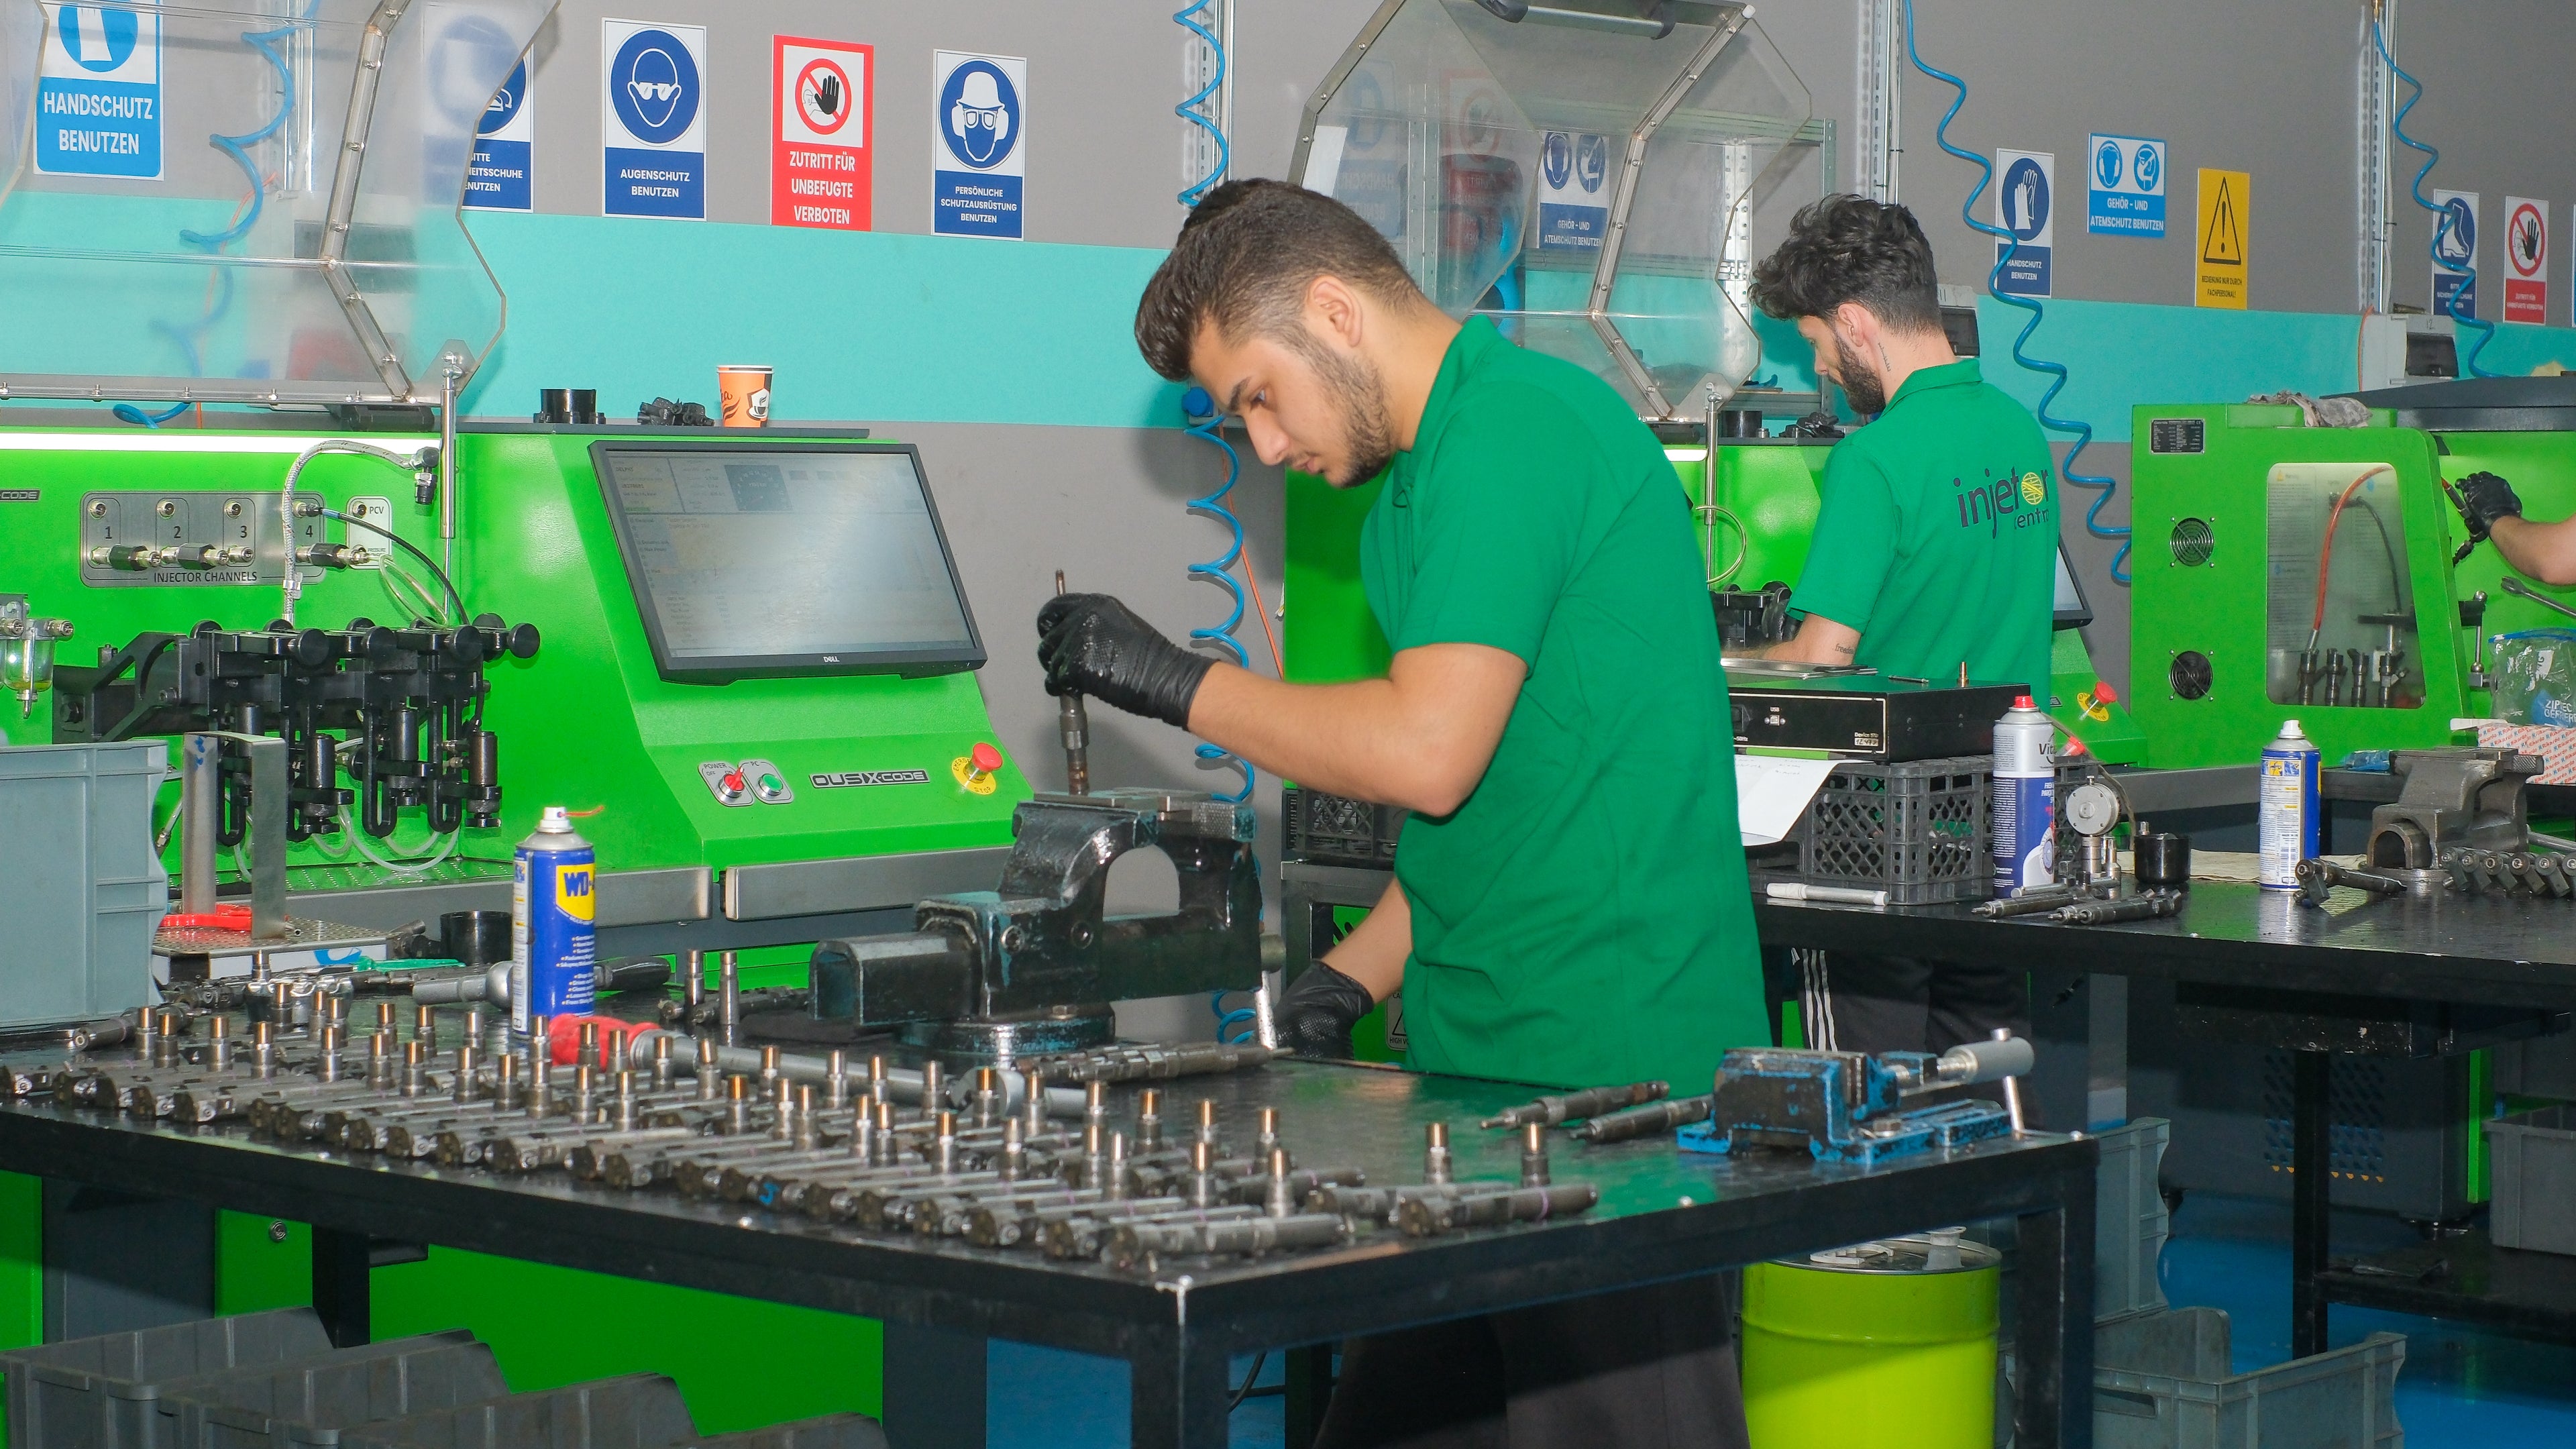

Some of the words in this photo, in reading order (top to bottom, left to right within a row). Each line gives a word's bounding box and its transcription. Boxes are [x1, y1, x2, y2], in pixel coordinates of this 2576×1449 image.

[44, 91, 153, 119] HANDSCHUTZ
[58, 129, 140, 155] BENUTZEN
[471, 153, 490, 162] ITTE
[790, 151, 833, 170] ZUTRITT
[835, 151, 855, 172] FÜR
[620, 168, 690, 182] AUGENSCHUTZ
[631, 186, 679, 197] BENUTZEN
[792, 178, 853, 198] UNBEFUGTE
[955, 186, 1004, 197] PERSÖNLICHE
[941, 199, 1017, 211] SCHUTZAUSRÜSTUNG
[2107, 196, 2129, 209] GEHÖR
[2135, 200, 2148, 211] UND
[794, 205, 850, 224] VERBOTEN
[961, 213, 997, 223] BENUTZEN
[1558, 219, 1574, 229] GEHÖR
[1579, 221, 1590, 231] UND
[2090, 215, 2132, 228] ATEMSCHUTZ
[2133, 219, 2164, 231] BENUTZEN
[2007, 259, 2042, 268] HANDSCHUTZ
[2011, 271, 2037, 280] BENUTZEN
[370, 506, 384, 515] PCV
[105, 526, 113, 539] 1
[173, 526, 181, 539] 2
[239, 525, 248, 539] 3
[305, 525, 313, 538] 4
[154, 573, 201, 583] INJECTOR
[204, 571, 258, 582] CHANNELS
